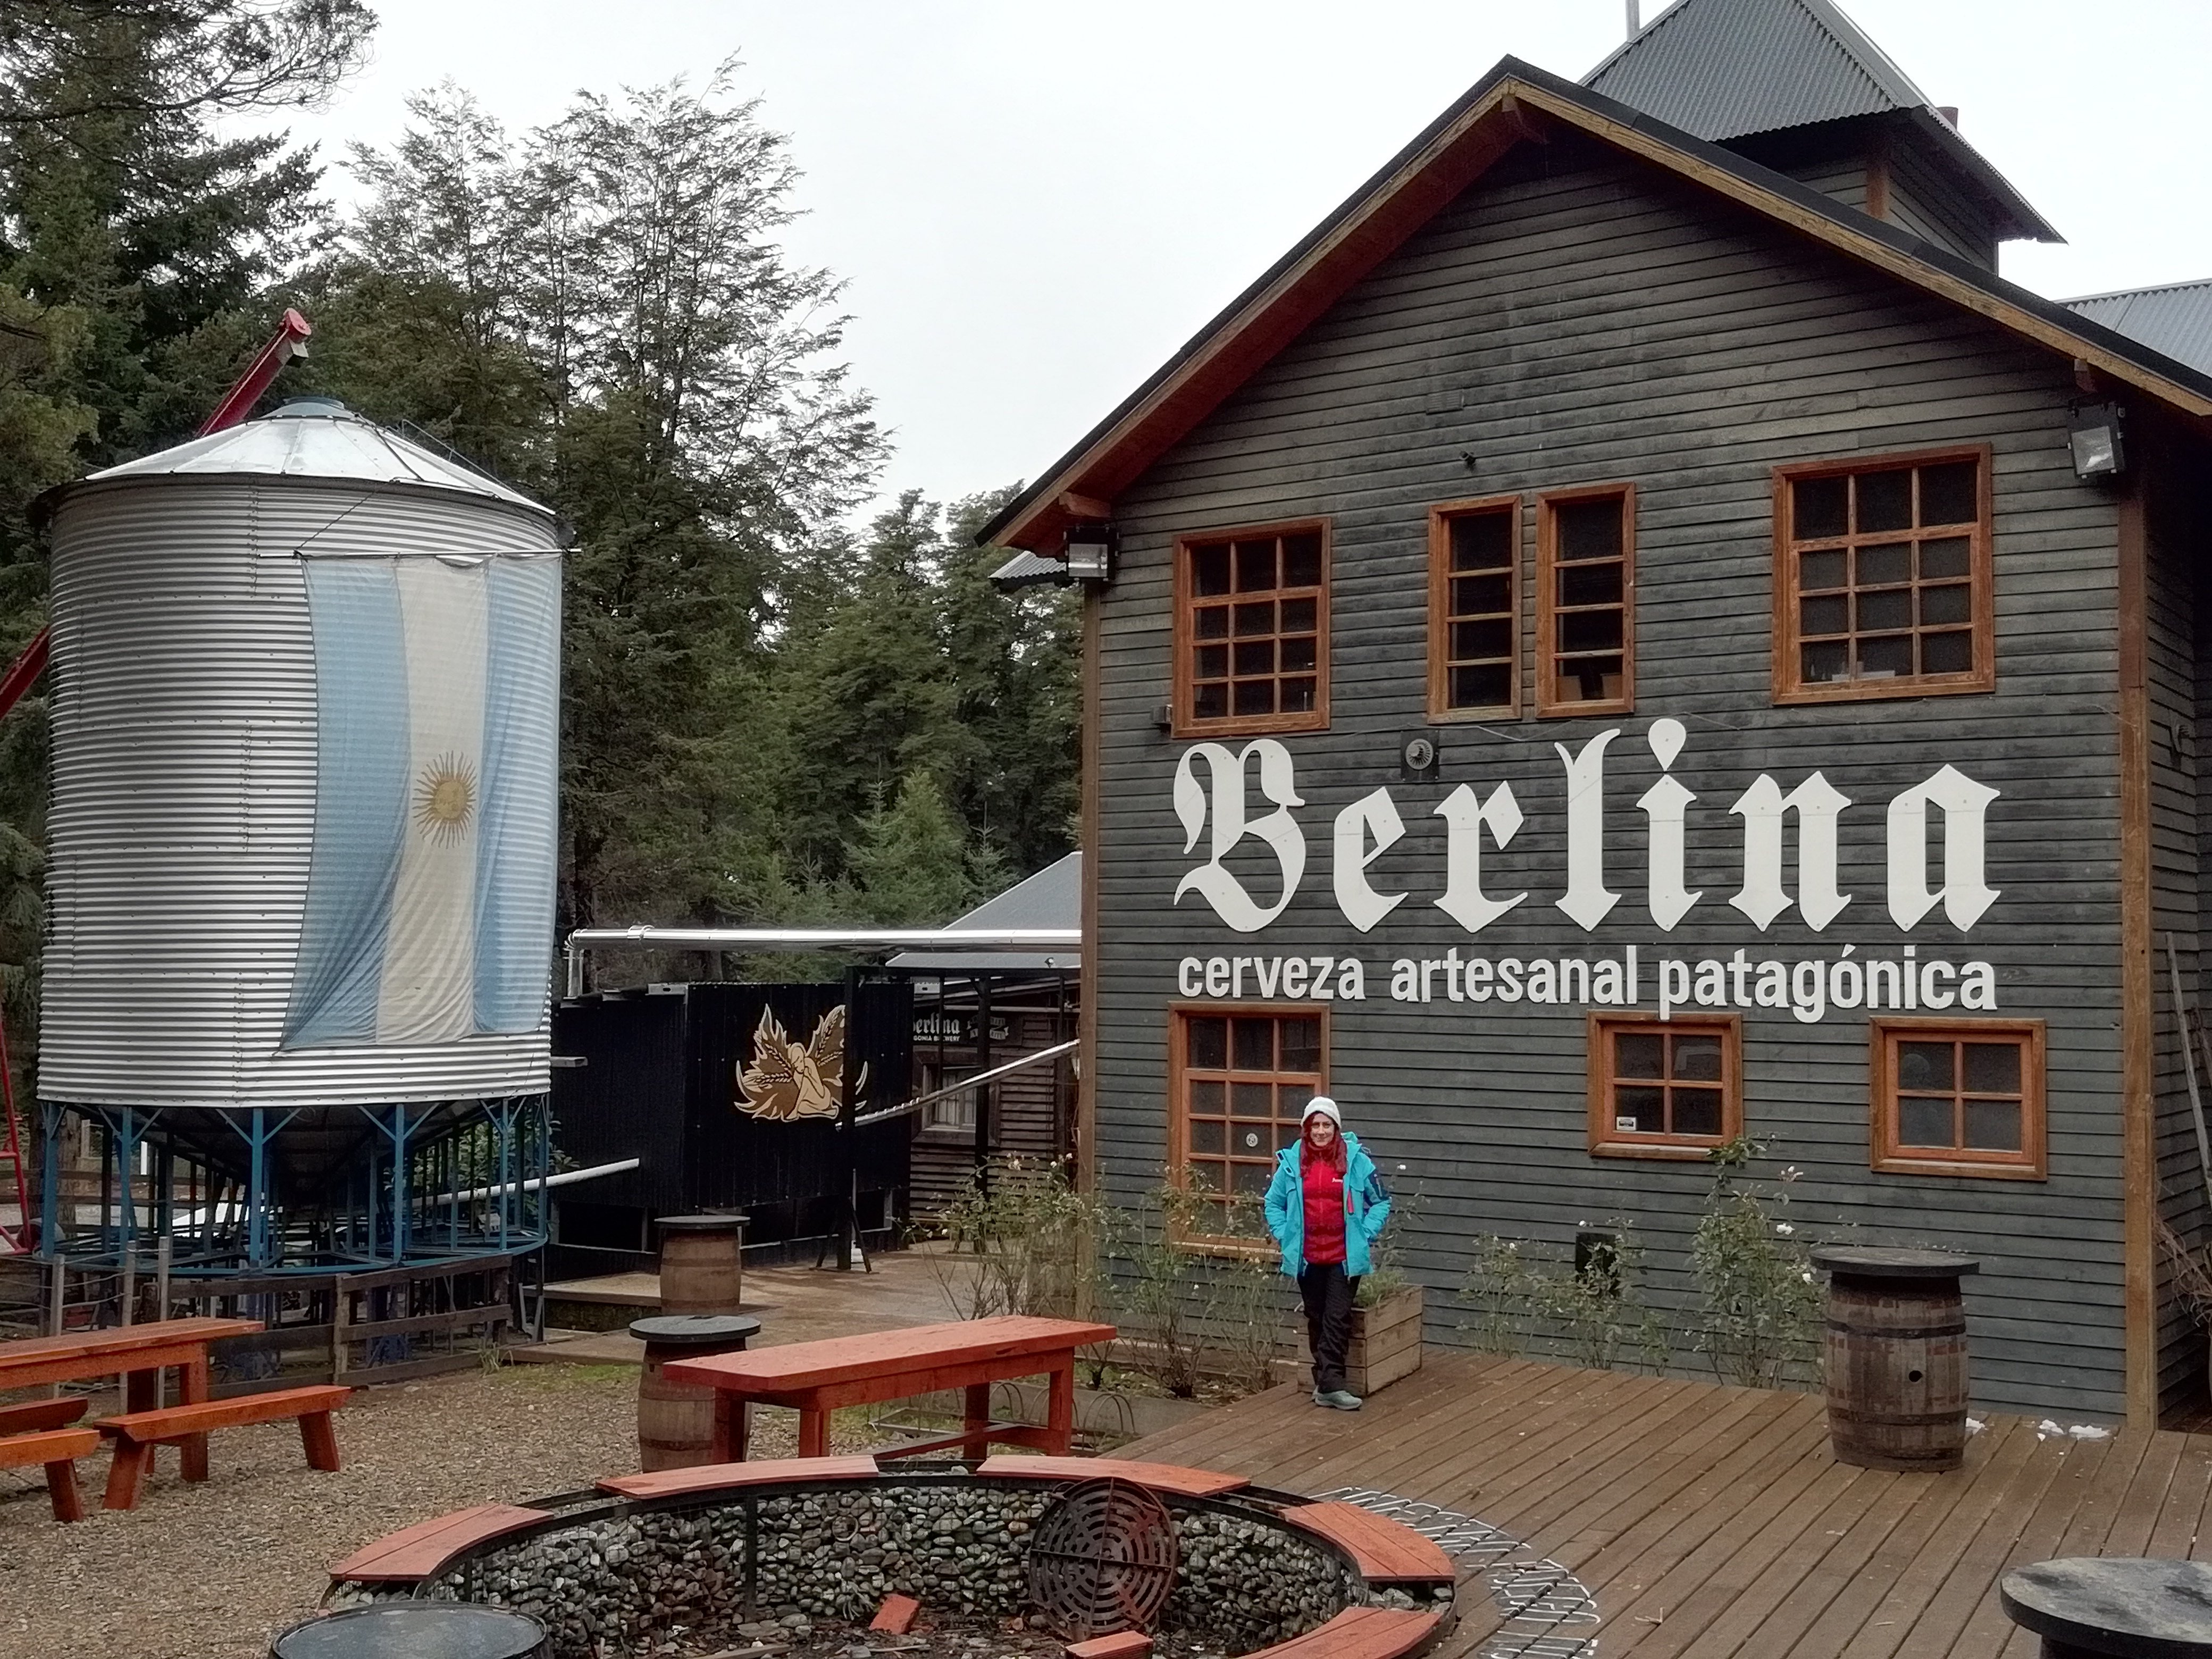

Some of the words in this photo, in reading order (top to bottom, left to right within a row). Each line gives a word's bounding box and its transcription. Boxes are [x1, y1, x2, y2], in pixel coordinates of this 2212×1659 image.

[1173, 718, 2001, 933] Berlina
[1178, 957, 1365, 1000] cerveza
[1390, 945, 1637, 1004] artesanal
[1659, 944, 1998, 1023] patagónica
[912, 1012, 960, 1035] erlina
